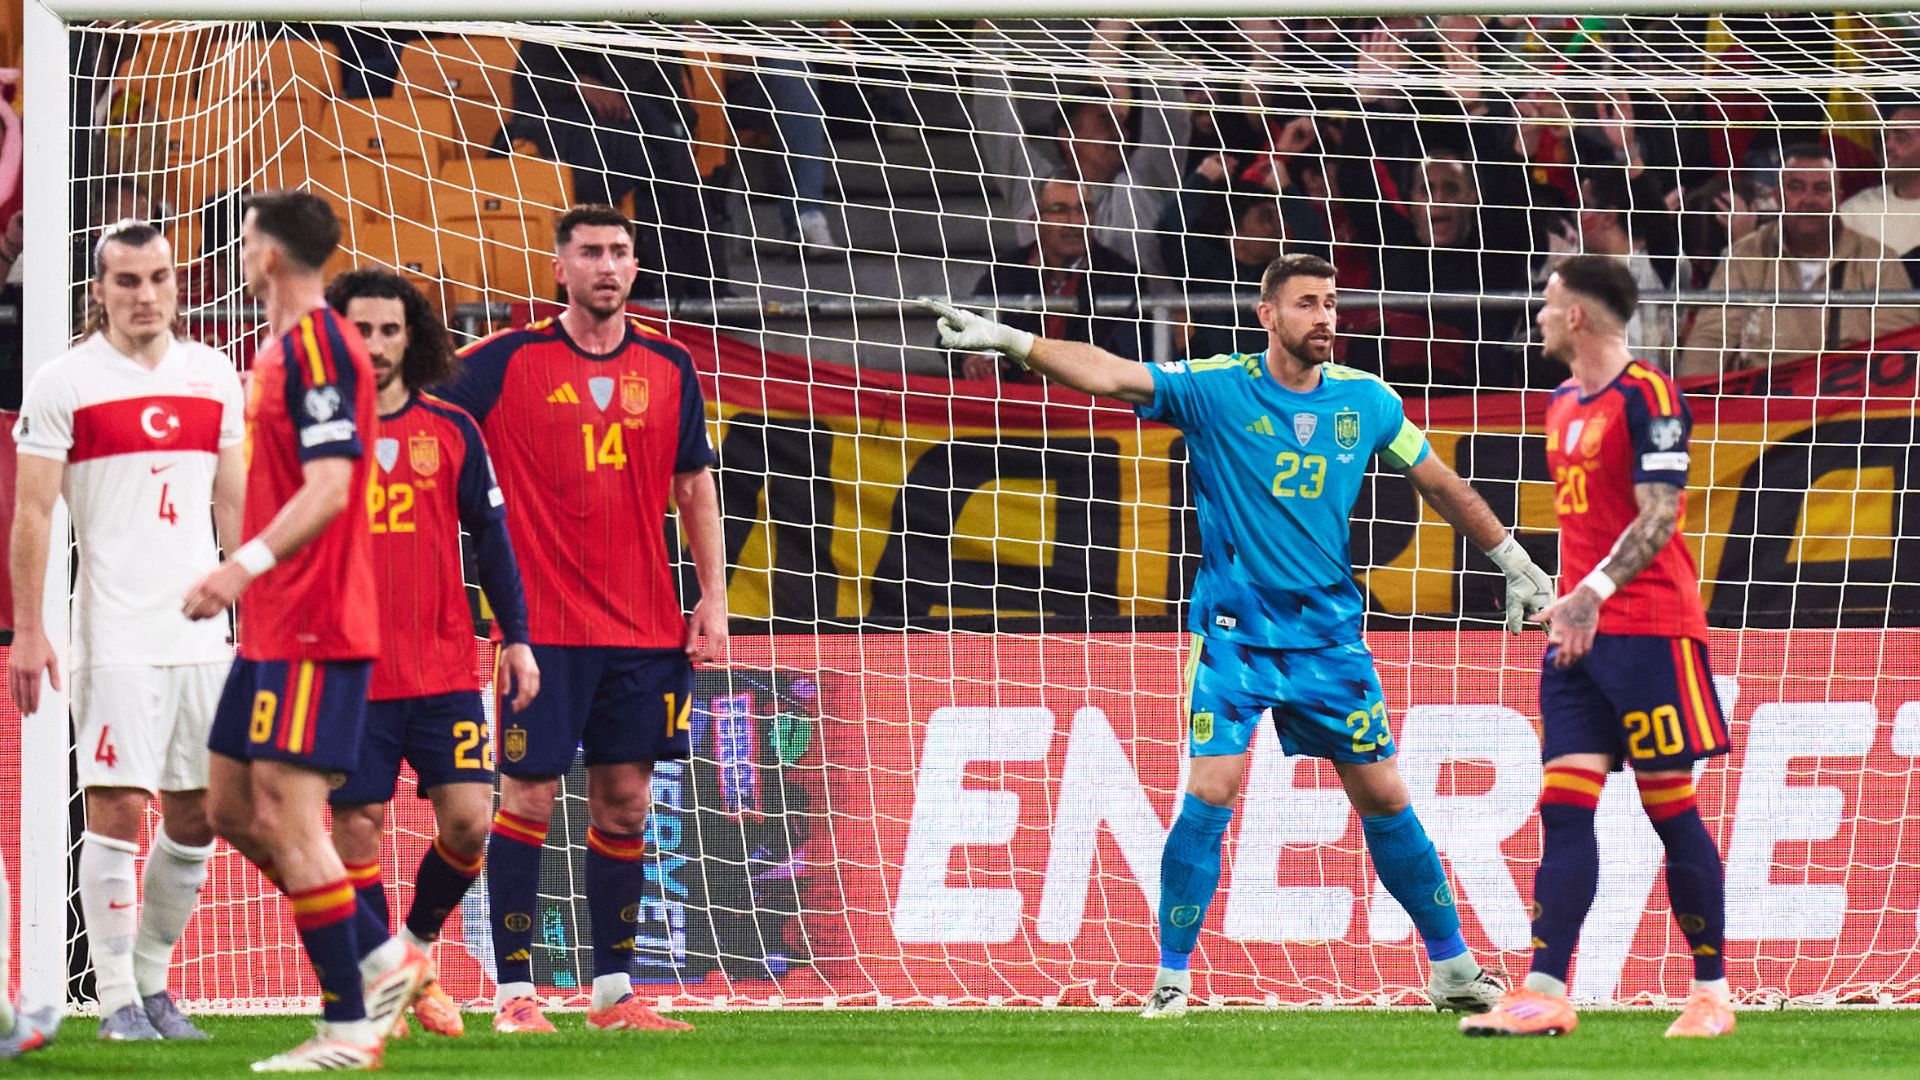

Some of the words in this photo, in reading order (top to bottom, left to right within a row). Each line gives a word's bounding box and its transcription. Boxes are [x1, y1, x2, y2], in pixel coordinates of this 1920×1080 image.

[582, 423, 627, 472] 14
[1272, 451, 1327, 499] 23
[1554, 465, 1588, 514] 20
[158, 483, 178, 526] 4
[369, 482, 416, 533] 22
[250, 689, 278, 744] 8
[1346, 701, 1391, 753] 23
[1622, 703, 1685, 759] 20
[94, 724, 118, 768] 4
